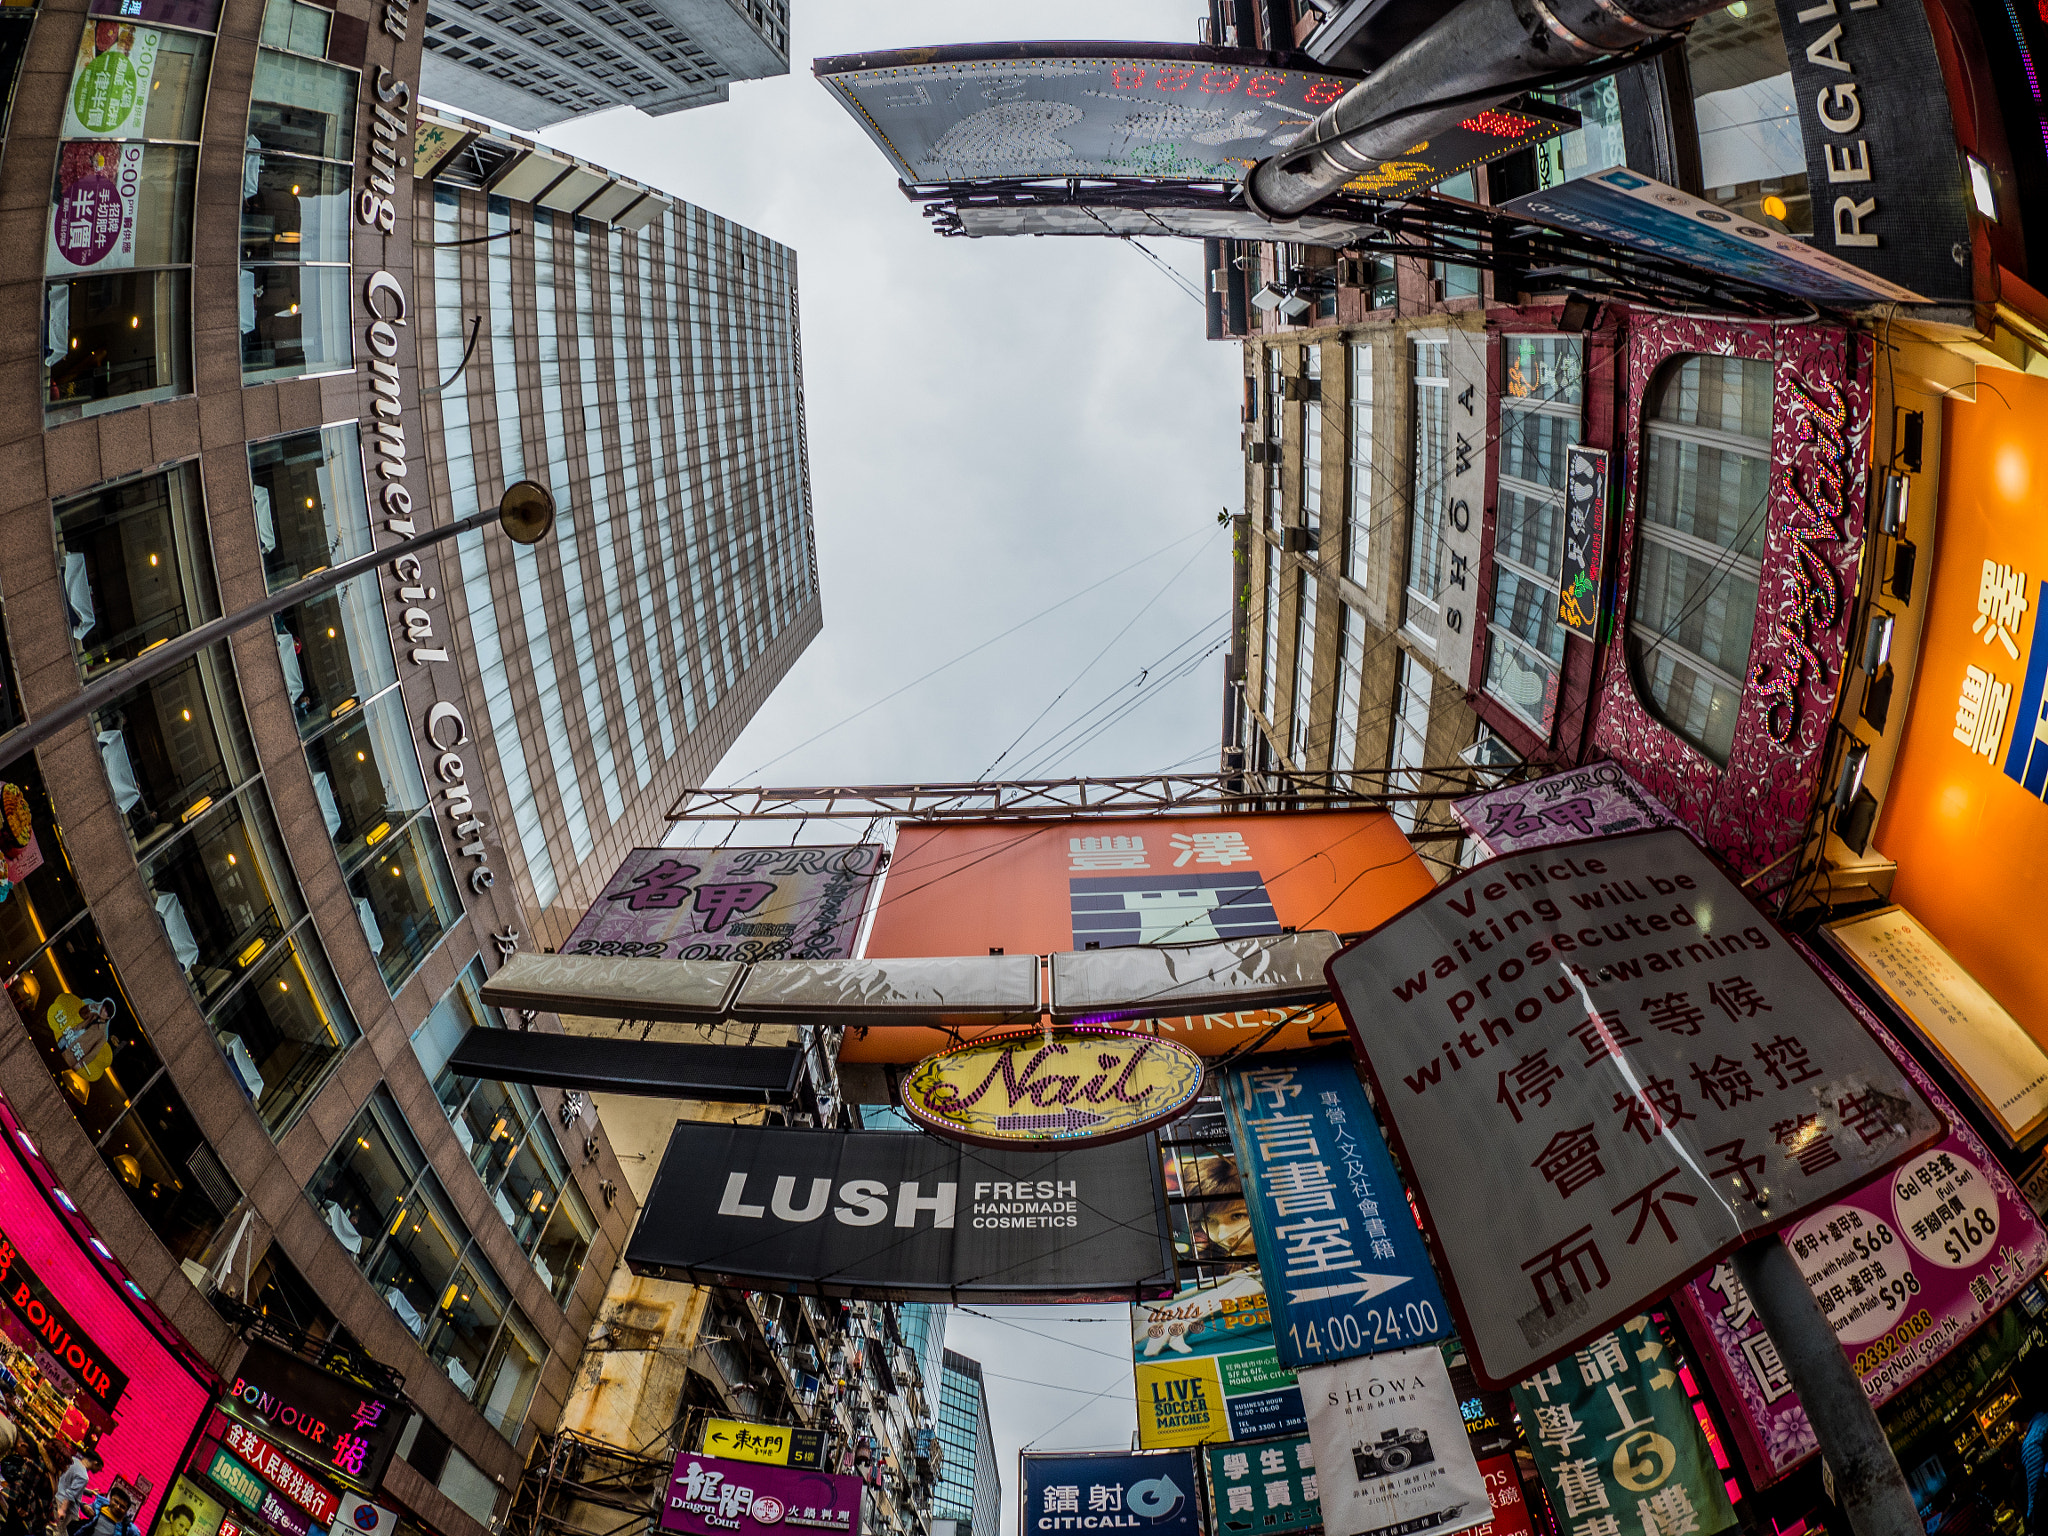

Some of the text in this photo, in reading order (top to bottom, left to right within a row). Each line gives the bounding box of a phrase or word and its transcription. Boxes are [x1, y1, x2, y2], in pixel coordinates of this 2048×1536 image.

[137, 34, 159, 78] 9:00
[86, 55, 112, 127] 一律半價
[120, 148, 140, 198] 9:00
[361, 64, 411, 236] Shing
[68, 189, 95, 250] 半價
[93, 188, 110, 249] 手切肥牛
[107, 202, 120, 233] 招牌
[127, 199, 135, 215] pm
[368, 270, 450, 666] Commercial
[1953, 558, 2030, 767] 豐澤
[430, 701, 496, 897] Centre
[1535, 765, 1624, 802] PRO
[1486, 798, 1596, 838] 名甲
[727, 848, 876, 877] PRO
[1068, 831, 1254, 872] 豐澤
[607, 858, 778, 934] 名甲
[1447, 853, 1608, 920] Vehicle
[1392, 870, 1698, 1004] waiting will be
[1447, 904, 1697, 1025] prosecuted
[1402, 924, 1772, 1096] without warning
[921, 1039, 1158, 1112] Nail
[1495, 974, 1774, 1125] 停車等候
[1529, 1034, 1825, 1201] 會被檢控
[717, 1171, 957, 1230] LUSH
[973, 1180, 1078, 1201] FRESH
[1238, 1066, 1363, 1280] 序言書室
[1896, 1152, 1959, 1202] Gel 甲全套
[1935, 1169, 1974, 1202] (Full Set)
[971, 1215, 1079, 1230] COSMETICS
[972, 1199, 1078, 1215] HANDMADE
[1520, 1086, 1898, 1320] 而不予警告
[1821, 1259, 1838, 1278] with
[1836, 1248, 1859, 1270] Polish
[1852, 1223, 1894, 1262] $68
[1943, 1206, 1997, 1264] $168
[1847, 1305, 1863, 1323] with
[1860, 1293, 1881, 1316] Polish
[1879, 1271, 1921, 1312] $98
[1969, 1245, 2027, 1304] 請上 1/F
[12, 1281, 111, 1400] BONJOUR
[1288, 1300, 1440, 1360] 14:00-24:00
[1897, 1308, 1934, 1345] 0188
[230, 1377, 327, 1444] BONJOUR
[1151, 1378, 1206, 1404] LIVE
[1154, 1399, 1209, 1418] SOCCER
[1156, 1412, 1211, 1430] MATCHES
[212, 1454, 263, 1499] JoShin
[225, 1423, 328, 1520] 金英人民幣找換行
[671, 1496, 716, 1515] Dragon
[704, 1513, 741, 1531] Court
[787, 1504, 851, 1522] 火鍋料理
[1038, 1514, 1141, 1530] CITICALL
